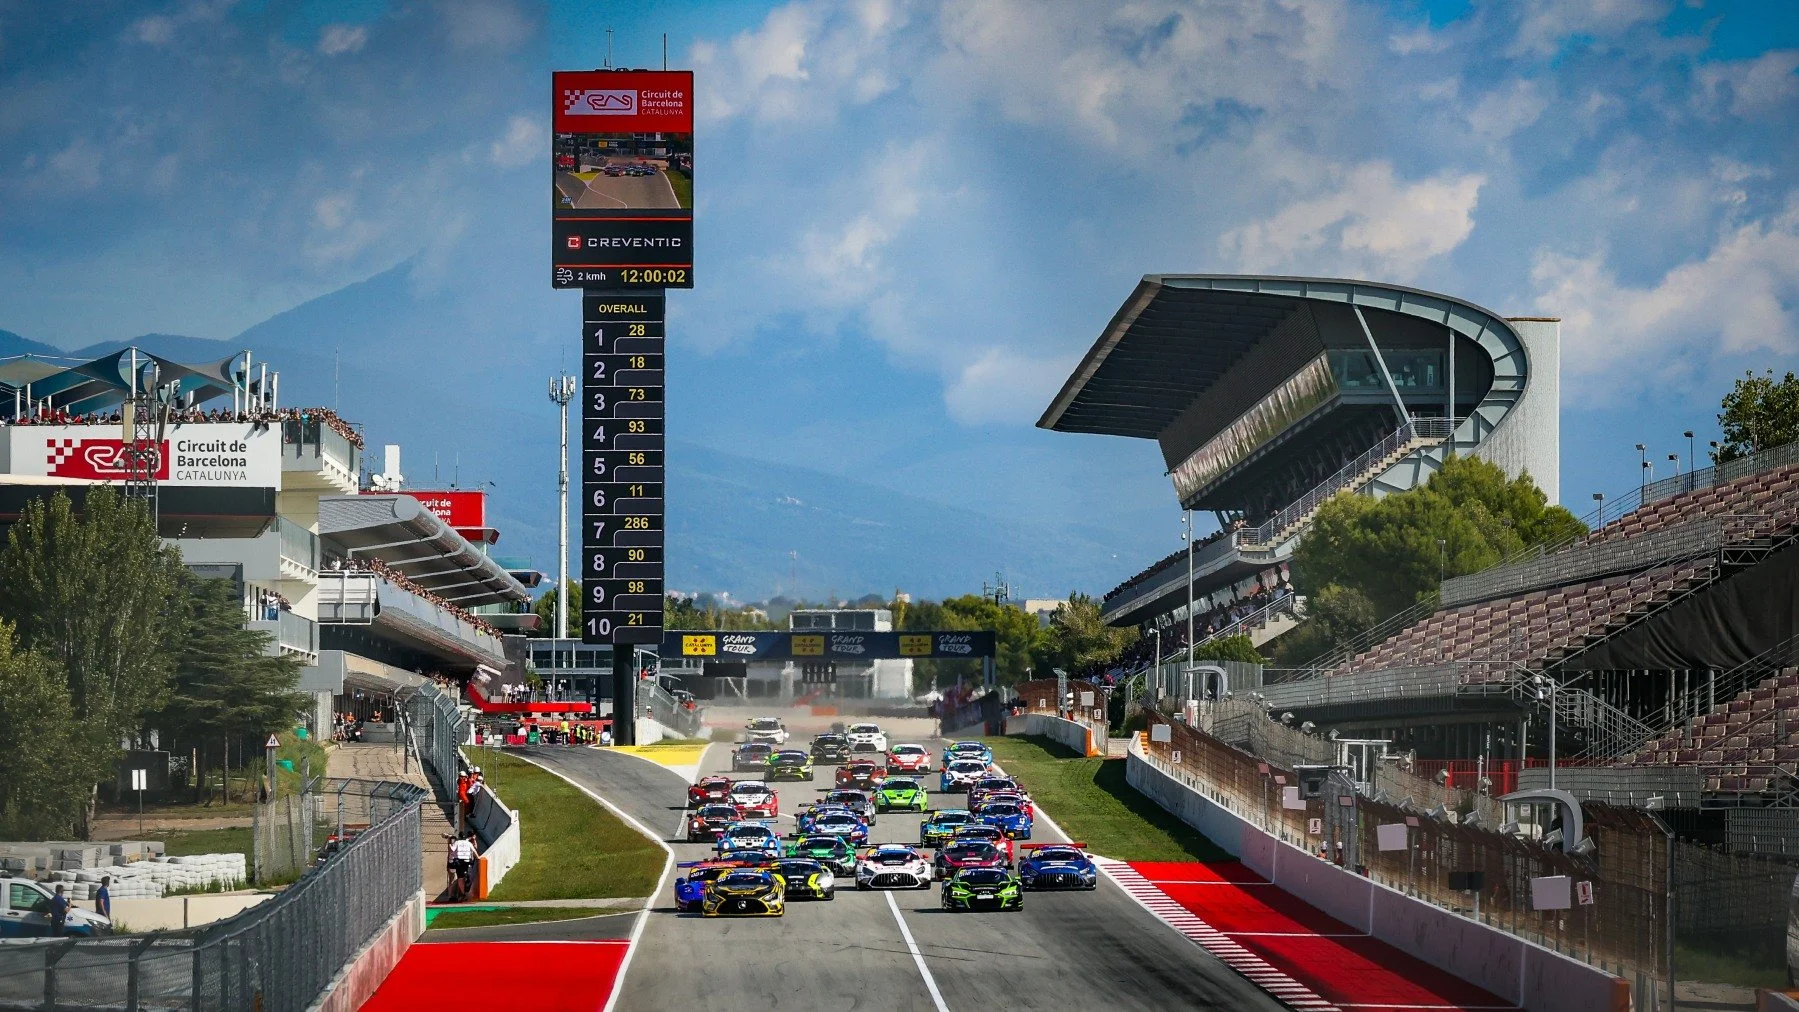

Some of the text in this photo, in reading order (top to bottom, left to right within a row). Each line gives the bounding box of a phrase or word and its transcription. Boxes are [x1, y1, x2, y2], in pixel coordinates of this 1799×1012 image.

[641, 90, 683, 99] Circuit de
[641, 99, 683, 107] Barcelona
[588, 237, 682, 248] CREVENTIC
[577, 269, 686, 283] 2 kmh 12:00:02
[598, 304, 648, 314] OVERALL
[594, 324, 645, 346] 1 28
[593, 356, 645, 378] 2 18
[593, 388, 645, 411] 3 73
[592, 420, 645, 442] 4 93
[177, 438, 247, 453] Circuit de
[177, 454, 247, 467] Barcelona
[594, 452, 645, 475] 5 56
[176, 470, 247, 481] CATALUNYA
[440, 499, 452, 507] de
[593, 485, 643, 507] 6 11
[593, 517, 649, 538] 7 286
[593, 549, 645, 571] 8 90
[593, 581, 645, 604] 9 98
[587, 613, 643, 636] 10 21
[722, 634, 756, 644] GRAND
[726, 644, 752, 653] TOUR
